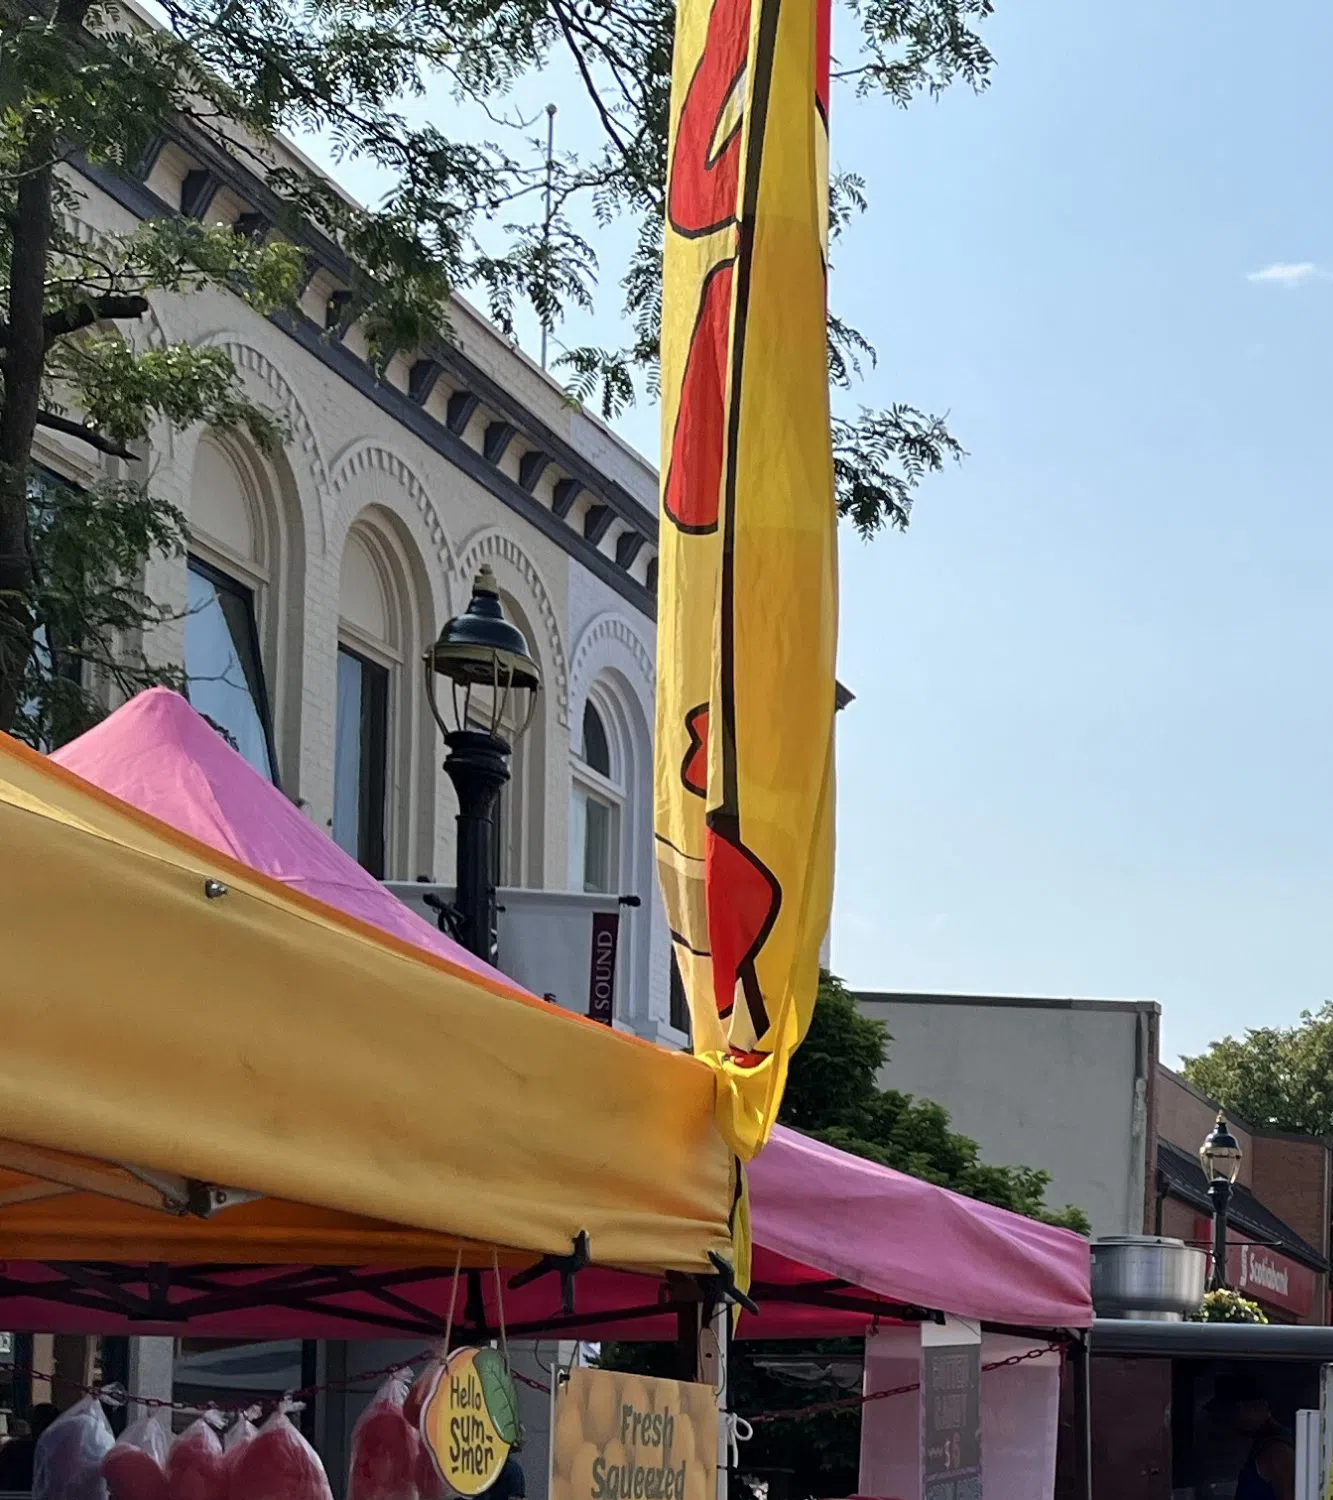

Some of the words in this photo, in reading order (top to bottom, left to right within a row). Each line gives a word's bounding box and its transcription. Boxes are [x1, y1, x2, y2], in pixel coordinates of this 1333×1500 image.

[595, 931, 613, 1010] SOUND
[1249, 1252, 1288, 1296] Scotiabank
[450, 1374, 482, 1411] Hello
[620, 1403, 674, 1447] Fresh
